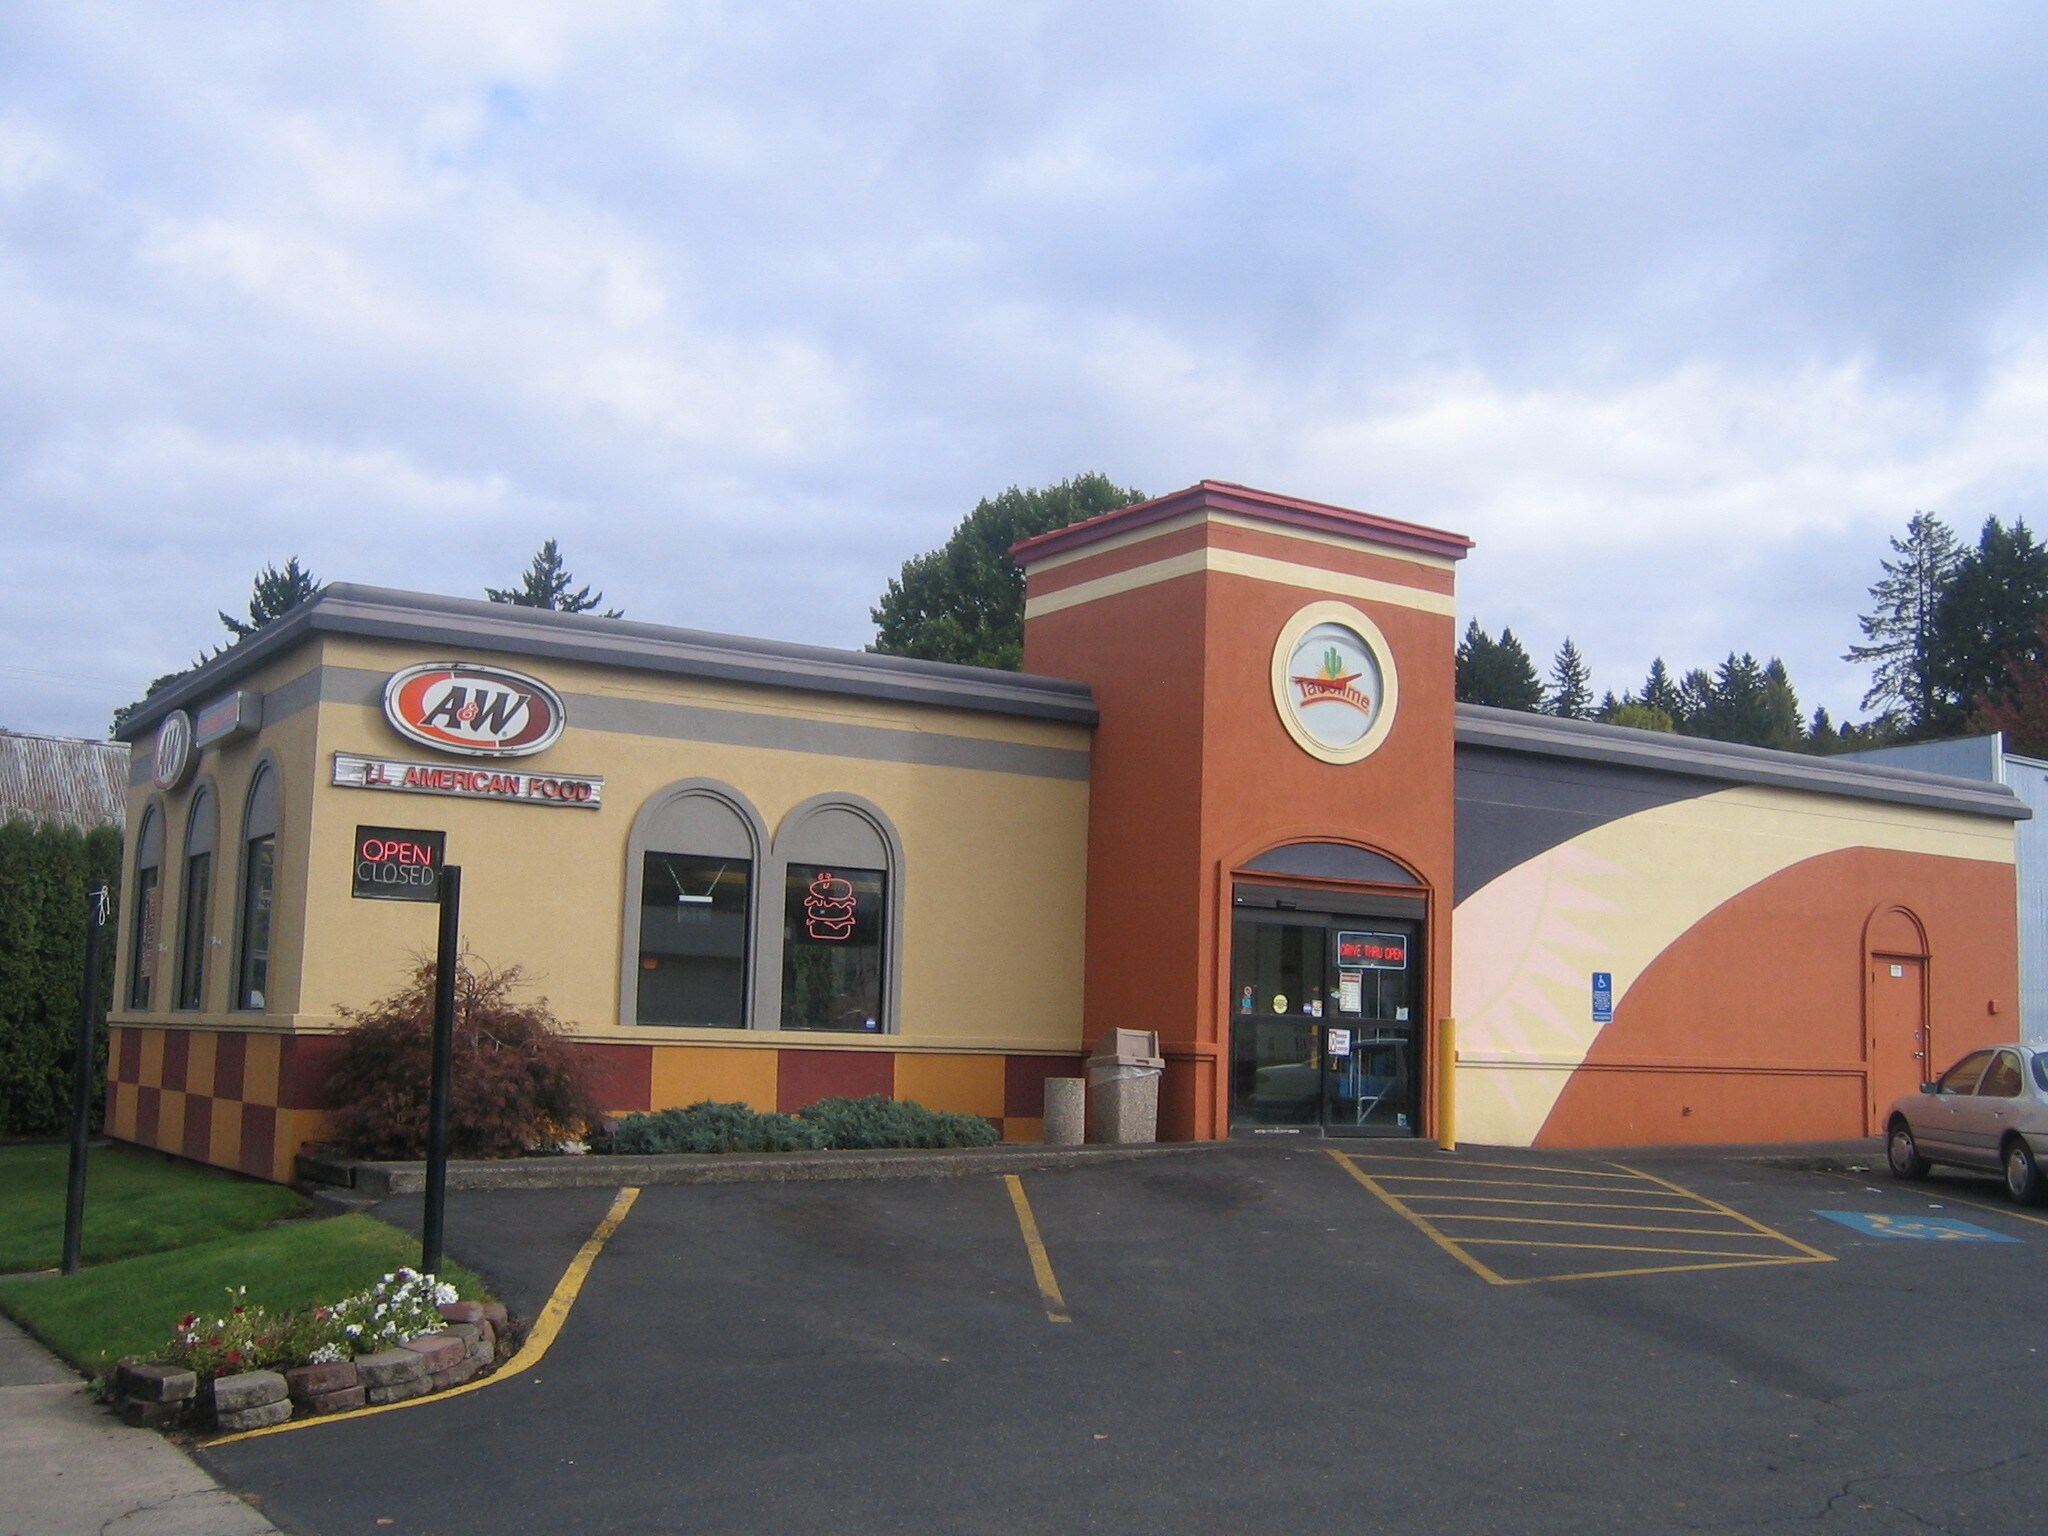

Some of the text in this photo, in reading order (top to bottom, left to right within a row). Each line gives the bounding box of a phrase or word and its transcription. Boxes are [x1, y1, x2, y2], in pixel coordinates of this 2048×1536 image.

[420, 685, 529, 736] A&W
[403, 766, 520, 795] AMERICAN
[529, 778, 592, 801] FOOD
[362, 839, 432, 865] OPEN
[357, 862, 434, 885] CLOSED
[1341, 943, 1404, 960] DRIVE THRU OPEN
